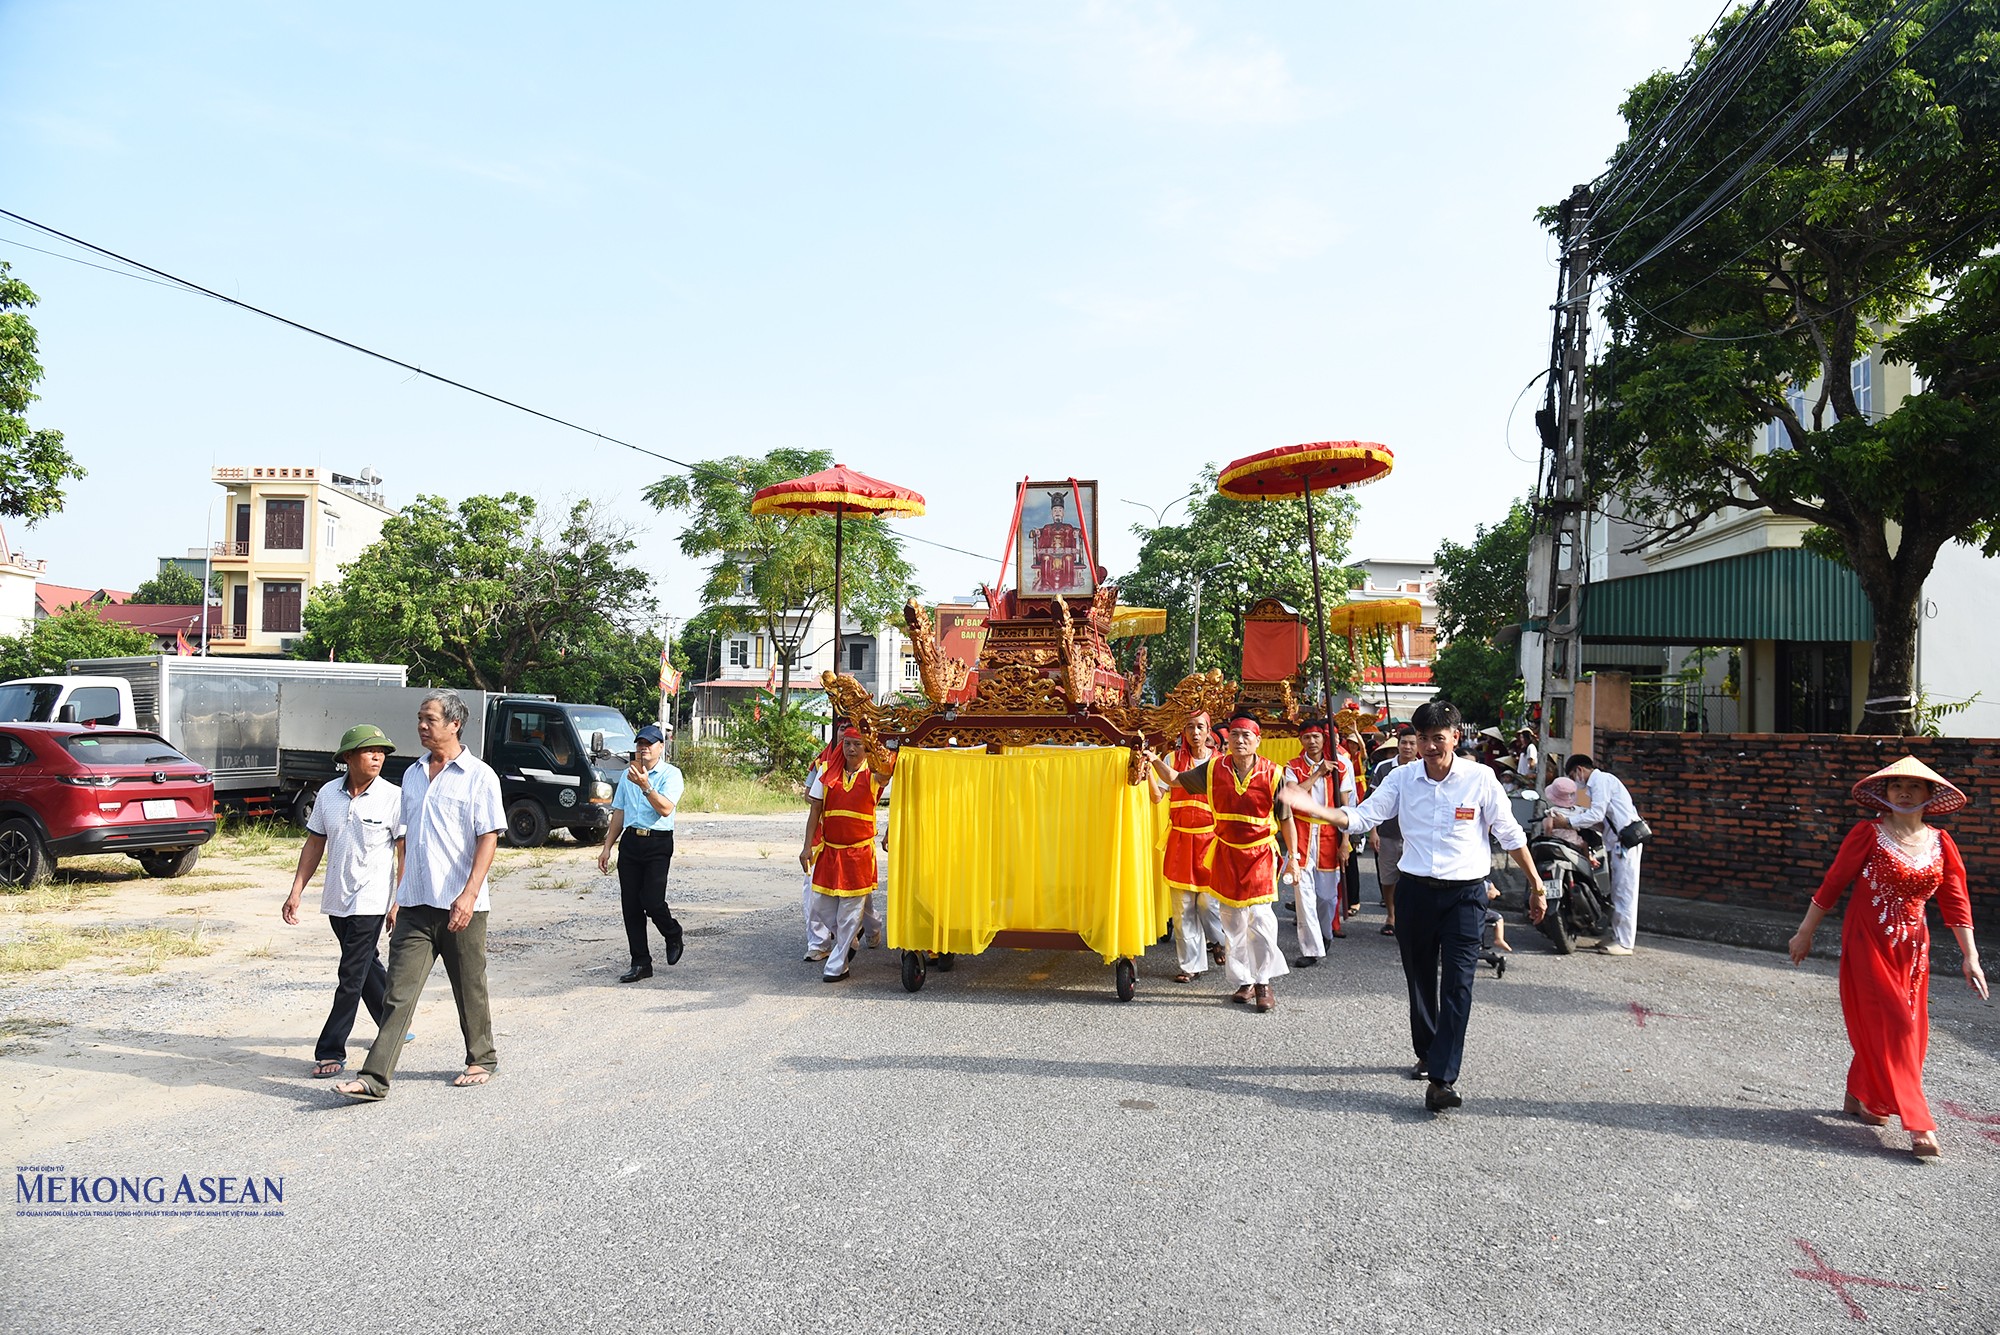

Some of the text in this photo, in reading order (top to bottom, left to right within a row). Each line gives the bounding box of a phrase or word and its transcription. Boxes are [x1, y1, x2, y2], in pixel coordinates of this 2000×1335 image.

[954, 616, 983, 627] ỦY BAN
[961, 630, 976, 639] BAN
